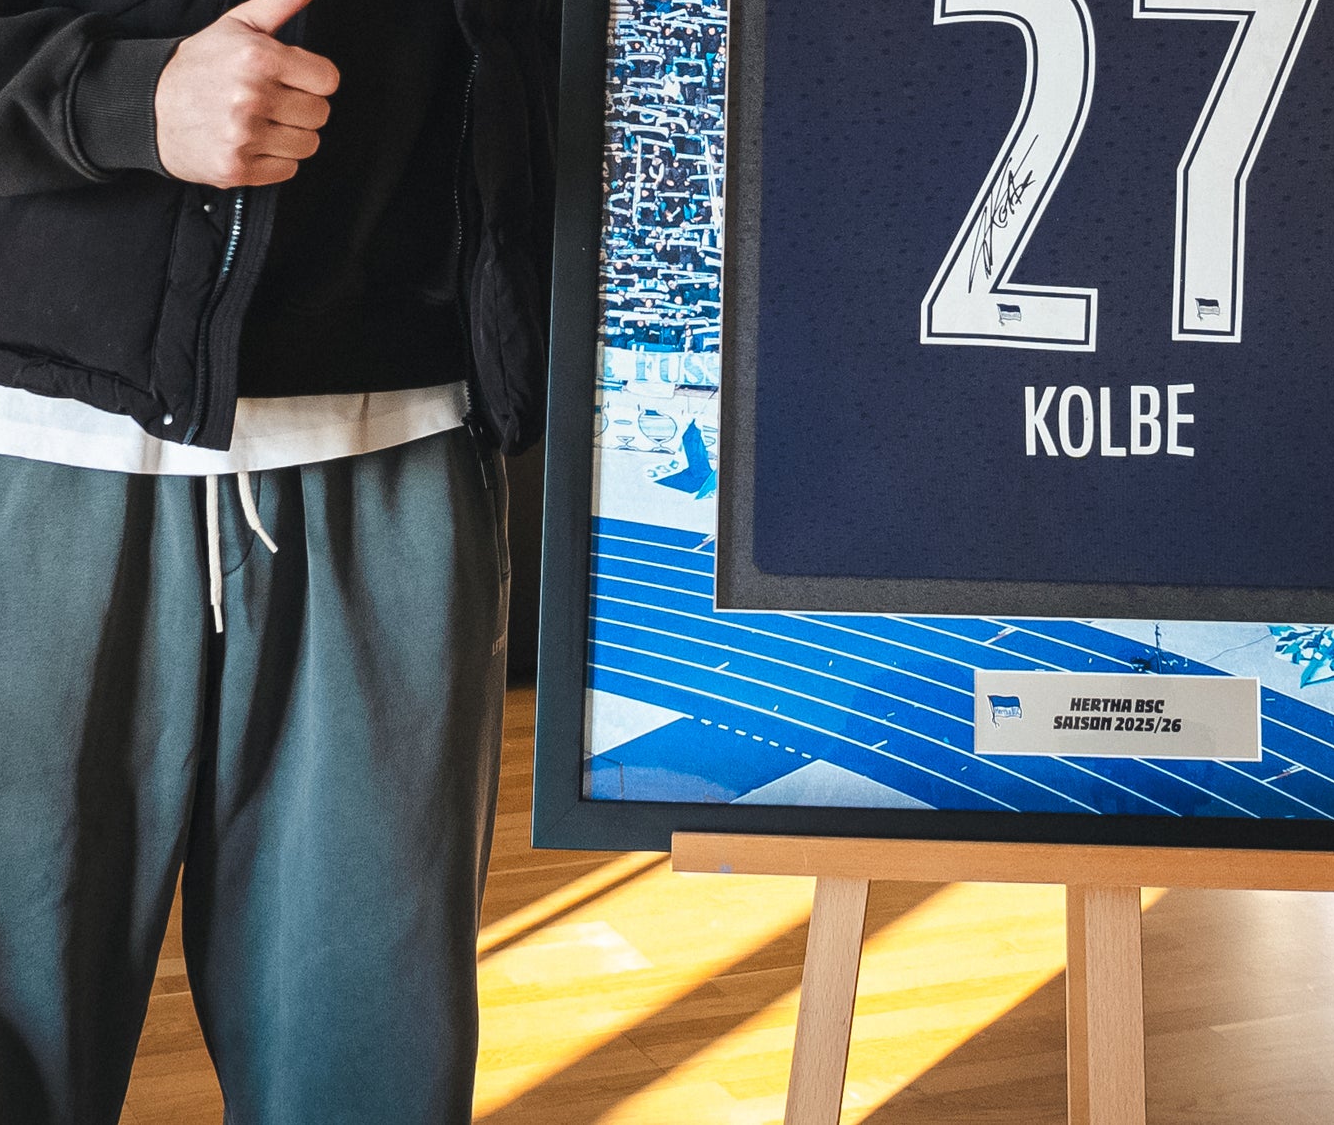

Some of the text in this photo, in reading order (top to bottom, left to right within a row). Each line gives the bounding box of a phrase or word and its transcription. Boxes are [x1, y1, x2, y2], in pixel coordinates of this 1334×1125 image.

[1024, 383, 1195, 457] KOLBE
[1070, 698, 1165, 714] HERTHA BSC
[1053, 716, 1182, 734] SAISON 2025/26
